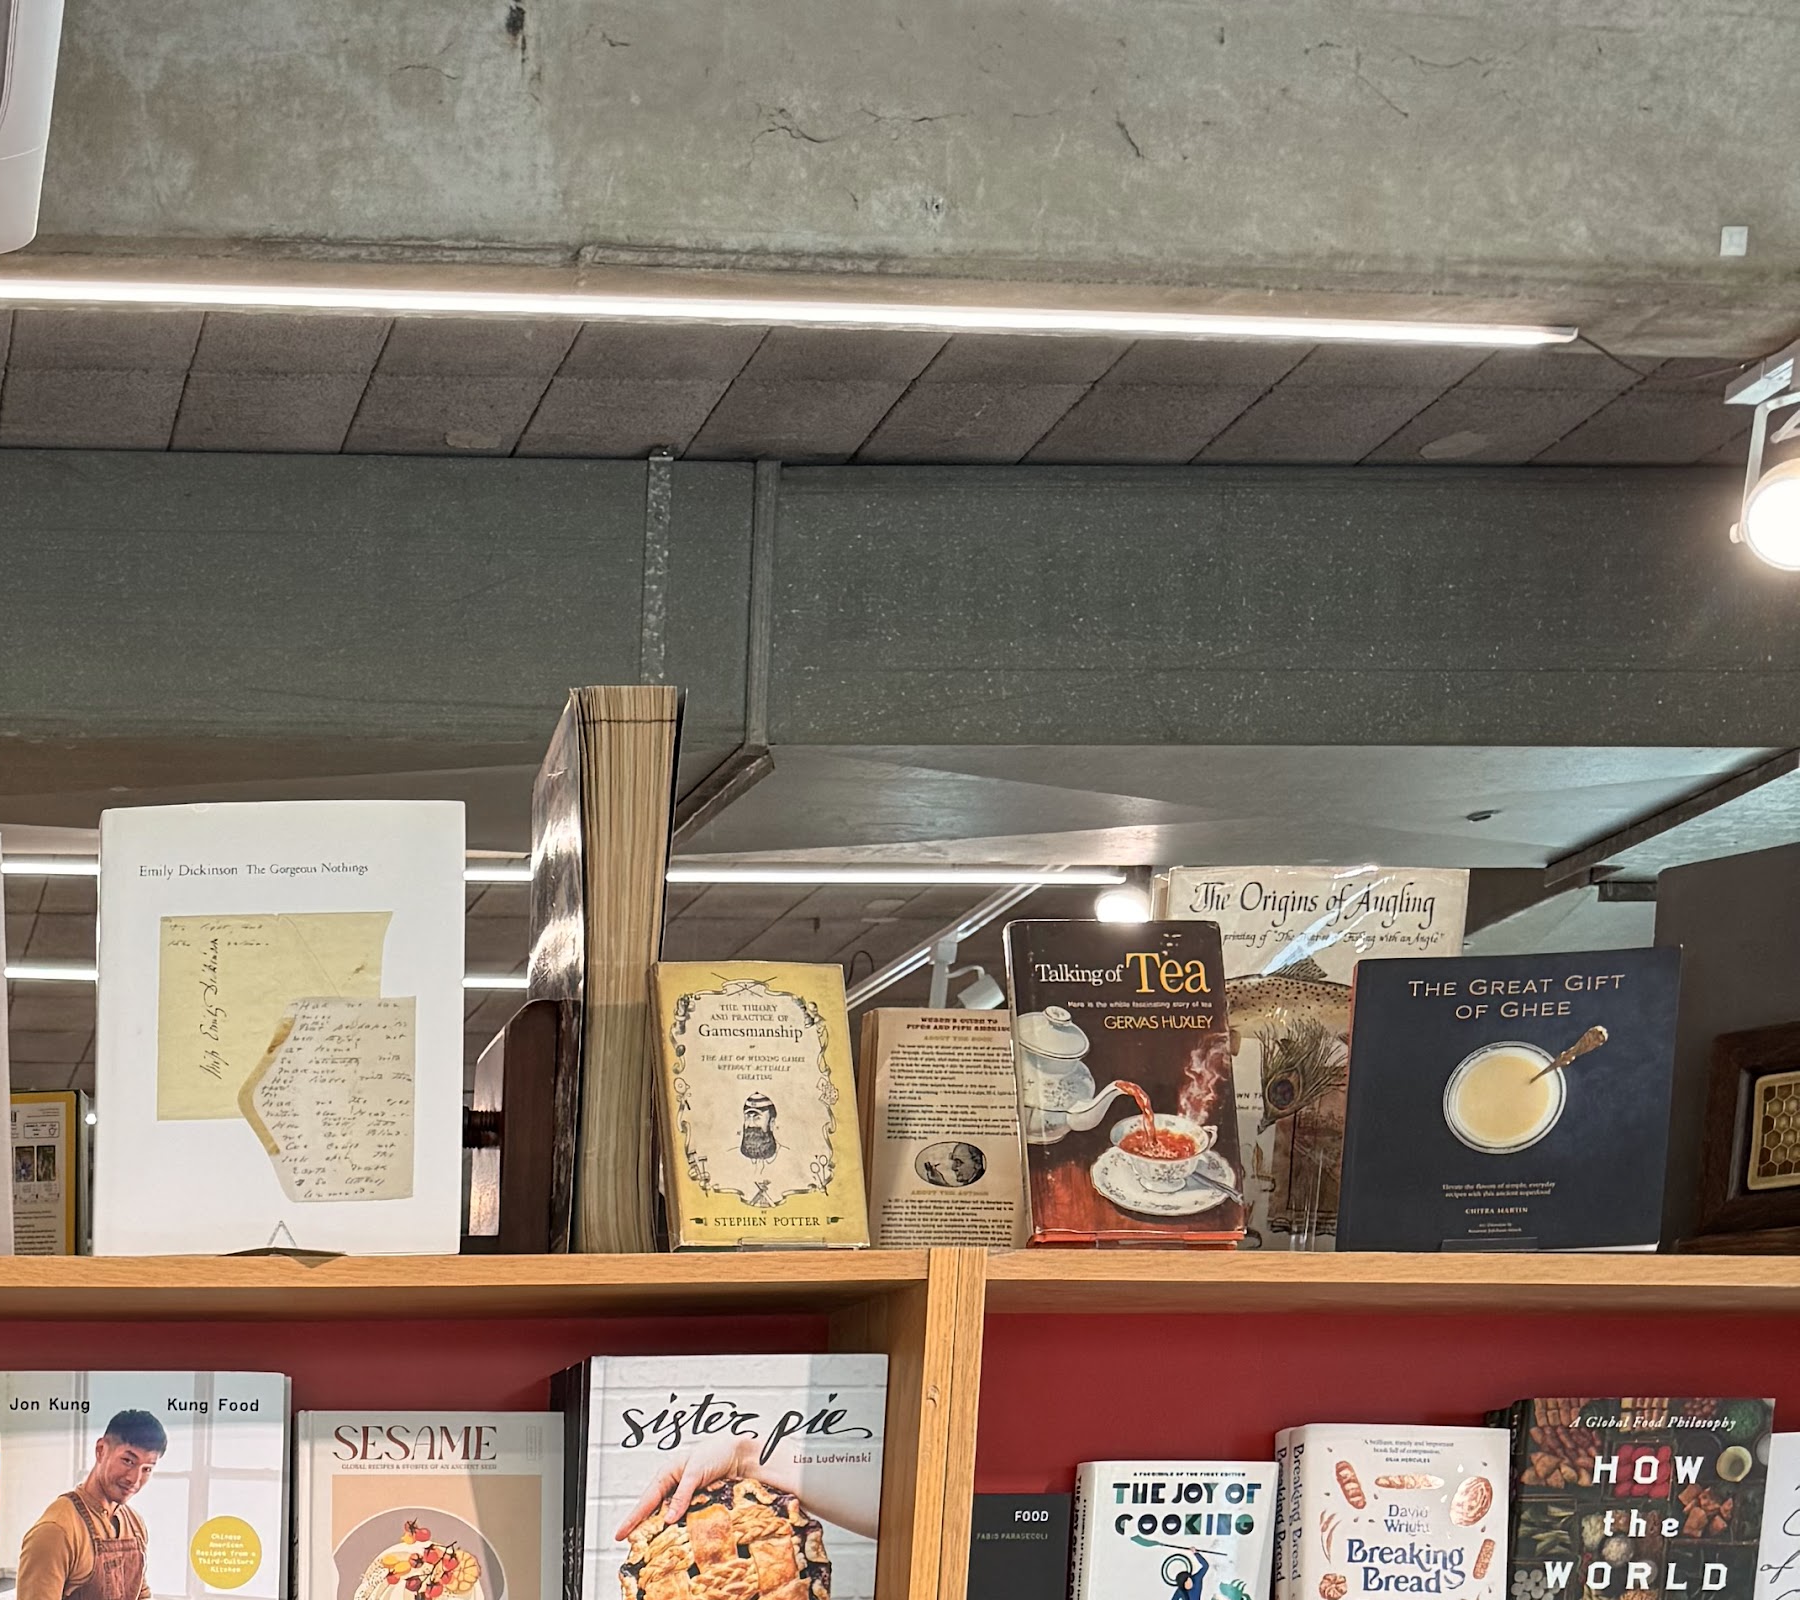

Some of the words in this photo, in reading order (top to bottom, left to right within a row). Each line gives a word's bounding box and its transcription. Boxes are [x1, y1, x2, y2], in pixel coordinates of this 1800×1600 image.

[139, 864, 174, 881] Emily
[178, 863, 238, 877] Dickinson
[245, 863, 267, 876] The
[269, 862, 318, 879] Gorgeous
[321, 861, 369, 876] Nothings
[1033, 961, 1104, 985] Talking
[1103, 963, 1124, 984] of
[1124, 951, 1212, 995] Tea
[1407, 979, 1458, 998] THE
[1468, 978, 1554, 997] GREAT
[1564, 974, 1626, 992] GIFT
[1103, 1014, 1158, 1031] GERVAS
[1160, 1013, 1214, 1030] HUXLEY
[1454, 1004, 1489, 1020] OF
[1499, 1000, 1572, 1019] GHEE
[697, 1022, 804, 1043] Gamesmanship
[713, 1216, 768, 1228] STEPHEN
[773, 1215, 822, 1228] POTTER
[9, 1397, 38, 1413] Jon
[46, 1398, 90, 1415] Kung
[167, 1397, 211, 1414] Kung
[218, 1398, 260, 1413] Food
[621, 1392, 759, 1450] sister
[758, 1392, 874, 1466] pie
[332, 1425, 498, 1461] SESAME
[793, 1454, 811, 1465] Lisa
[815, 1452, 872, 1465] Ludwinski
[1591, 1455, 1703, 1485] HOW
[1604, 1510, 1681, 1539] the
[1346, 1537, 1466, 1590] Breaking
[1361, 1565, 1444, 1596] Bread
[1543, 1561, 1729, 1594] WORLD
